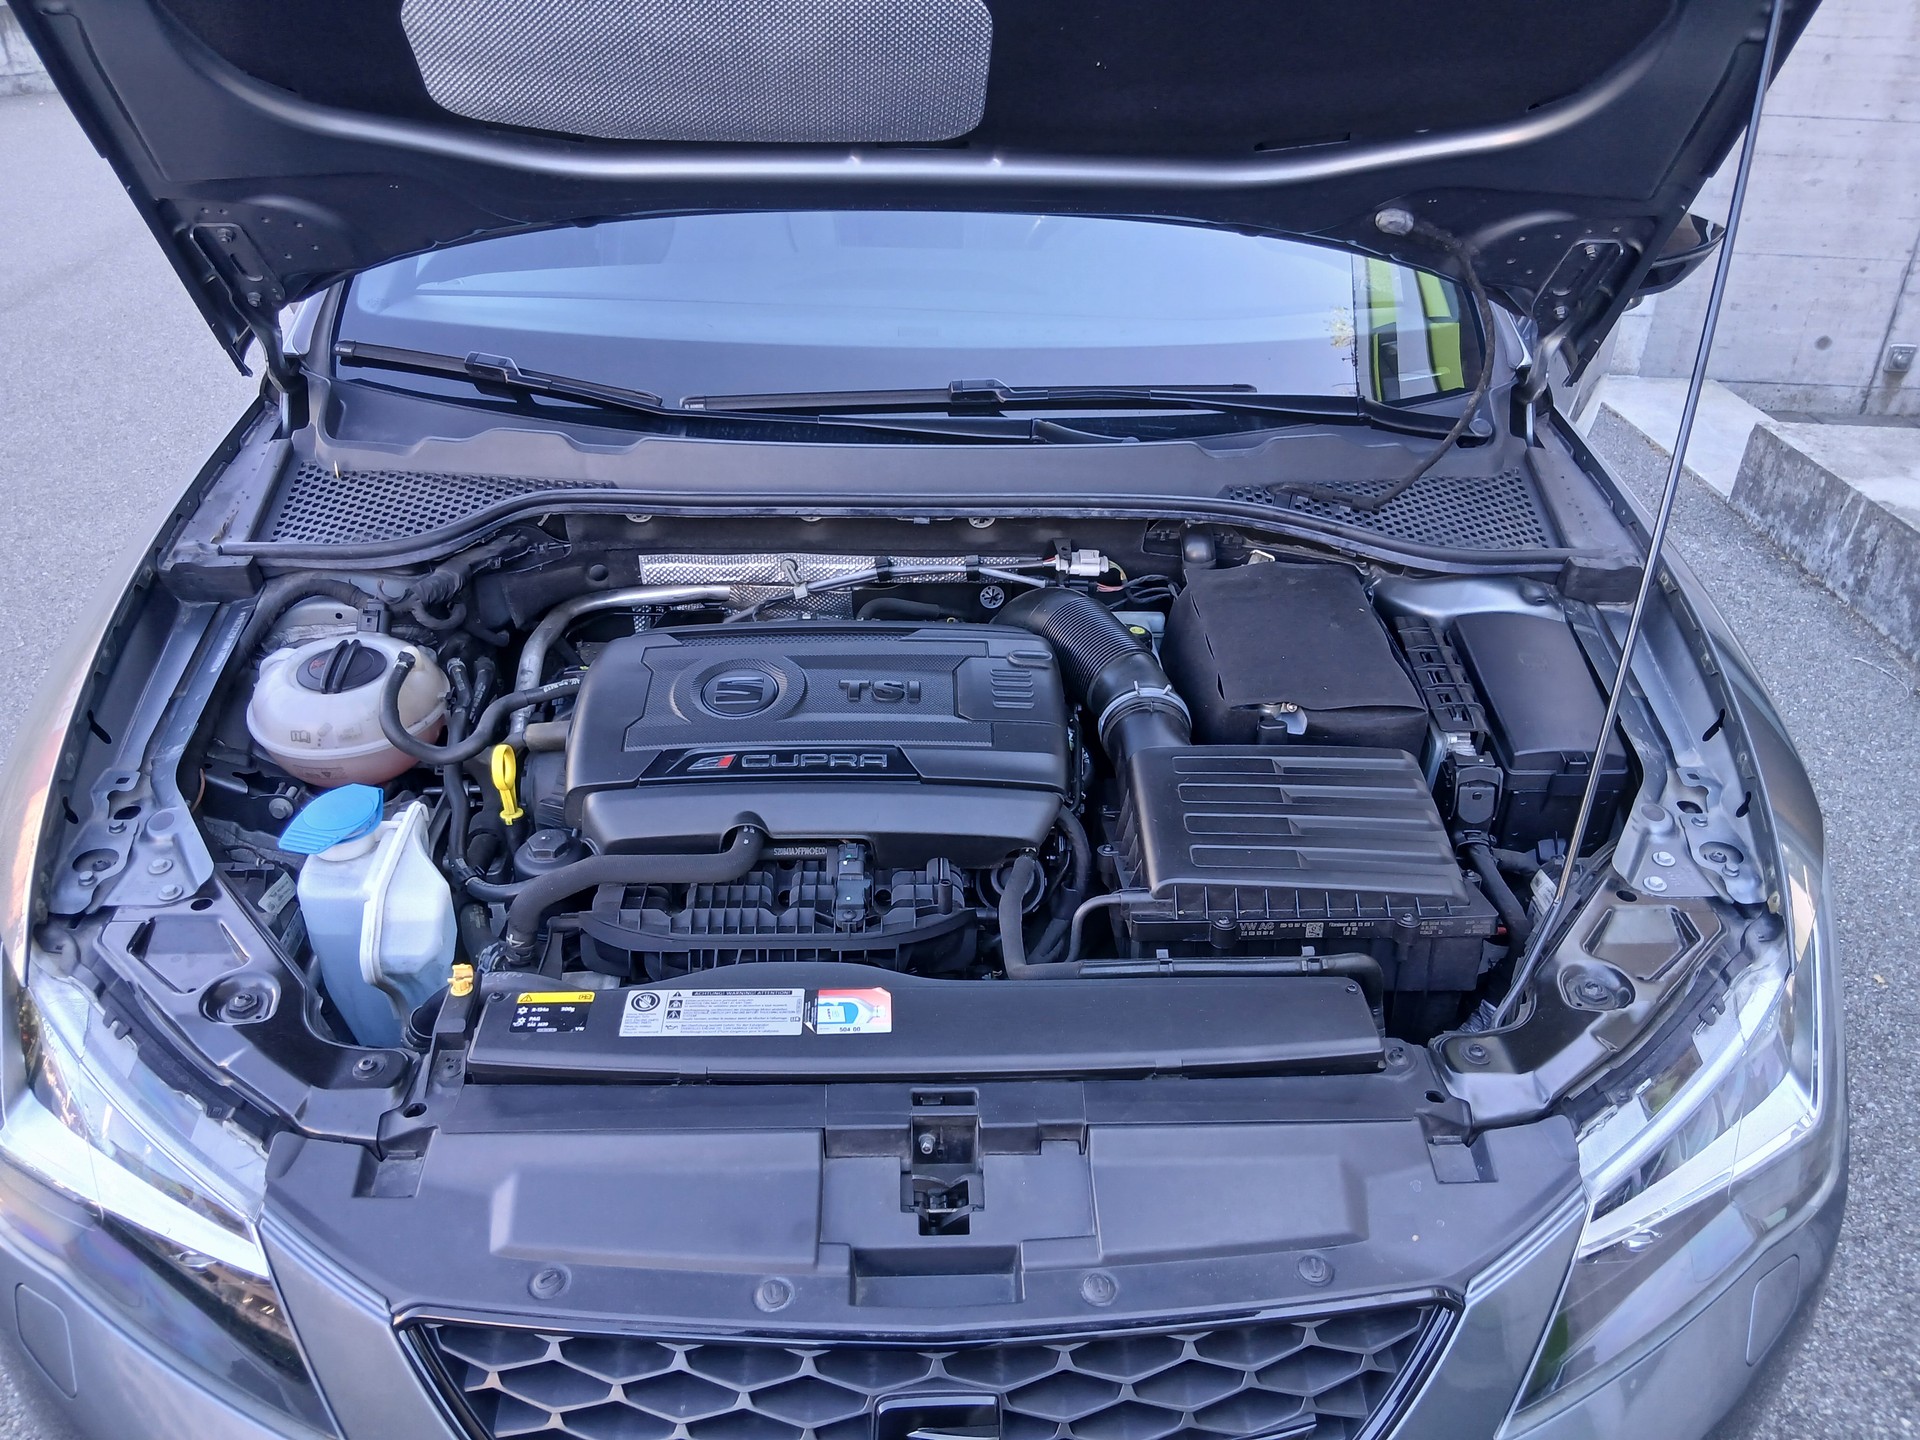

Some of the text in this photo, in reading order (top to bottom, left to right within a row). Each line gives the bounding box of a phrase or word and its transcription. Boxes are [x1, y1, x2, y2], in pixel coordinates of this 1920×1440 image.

[838, 679, 922, 702] TSI
[741, 753, 888, 769] CUPRA
[1239, 922, 1258, 931] VW
[1258, 922, 1275, 931] AG
